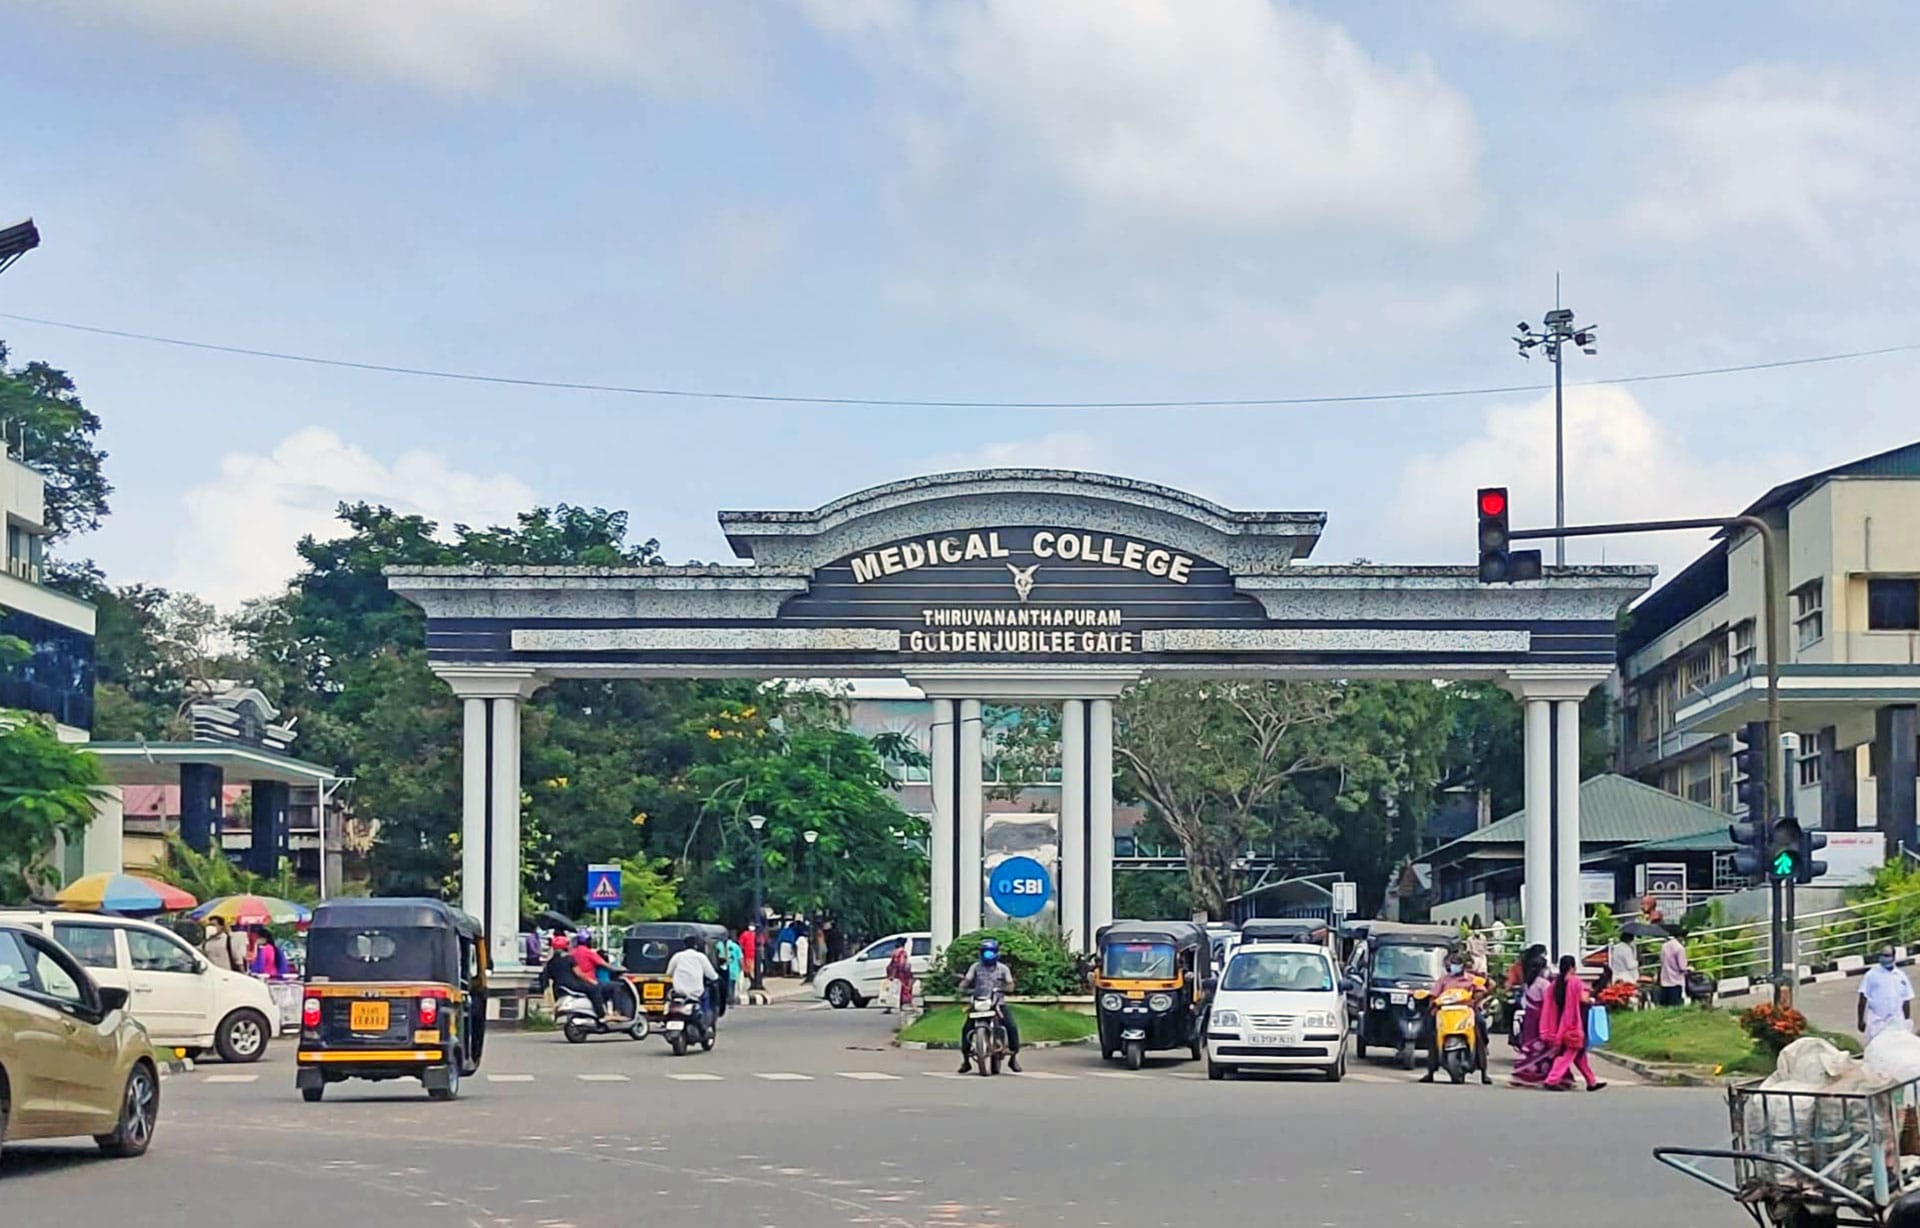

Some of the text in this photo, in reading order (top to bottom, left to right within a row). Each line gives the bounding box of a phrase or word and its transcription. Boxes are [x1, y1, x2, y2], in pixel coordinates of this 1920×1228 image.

[850, 531, 1194, 584] MEDICAL COLLEGE
[922, 609, 1121, 627] THIRUVANANTHAPURAM
[909, 631, 1132, 652] GOLDEN JUBILEE GATE
[1012, 878, 1043, 895] SBI
